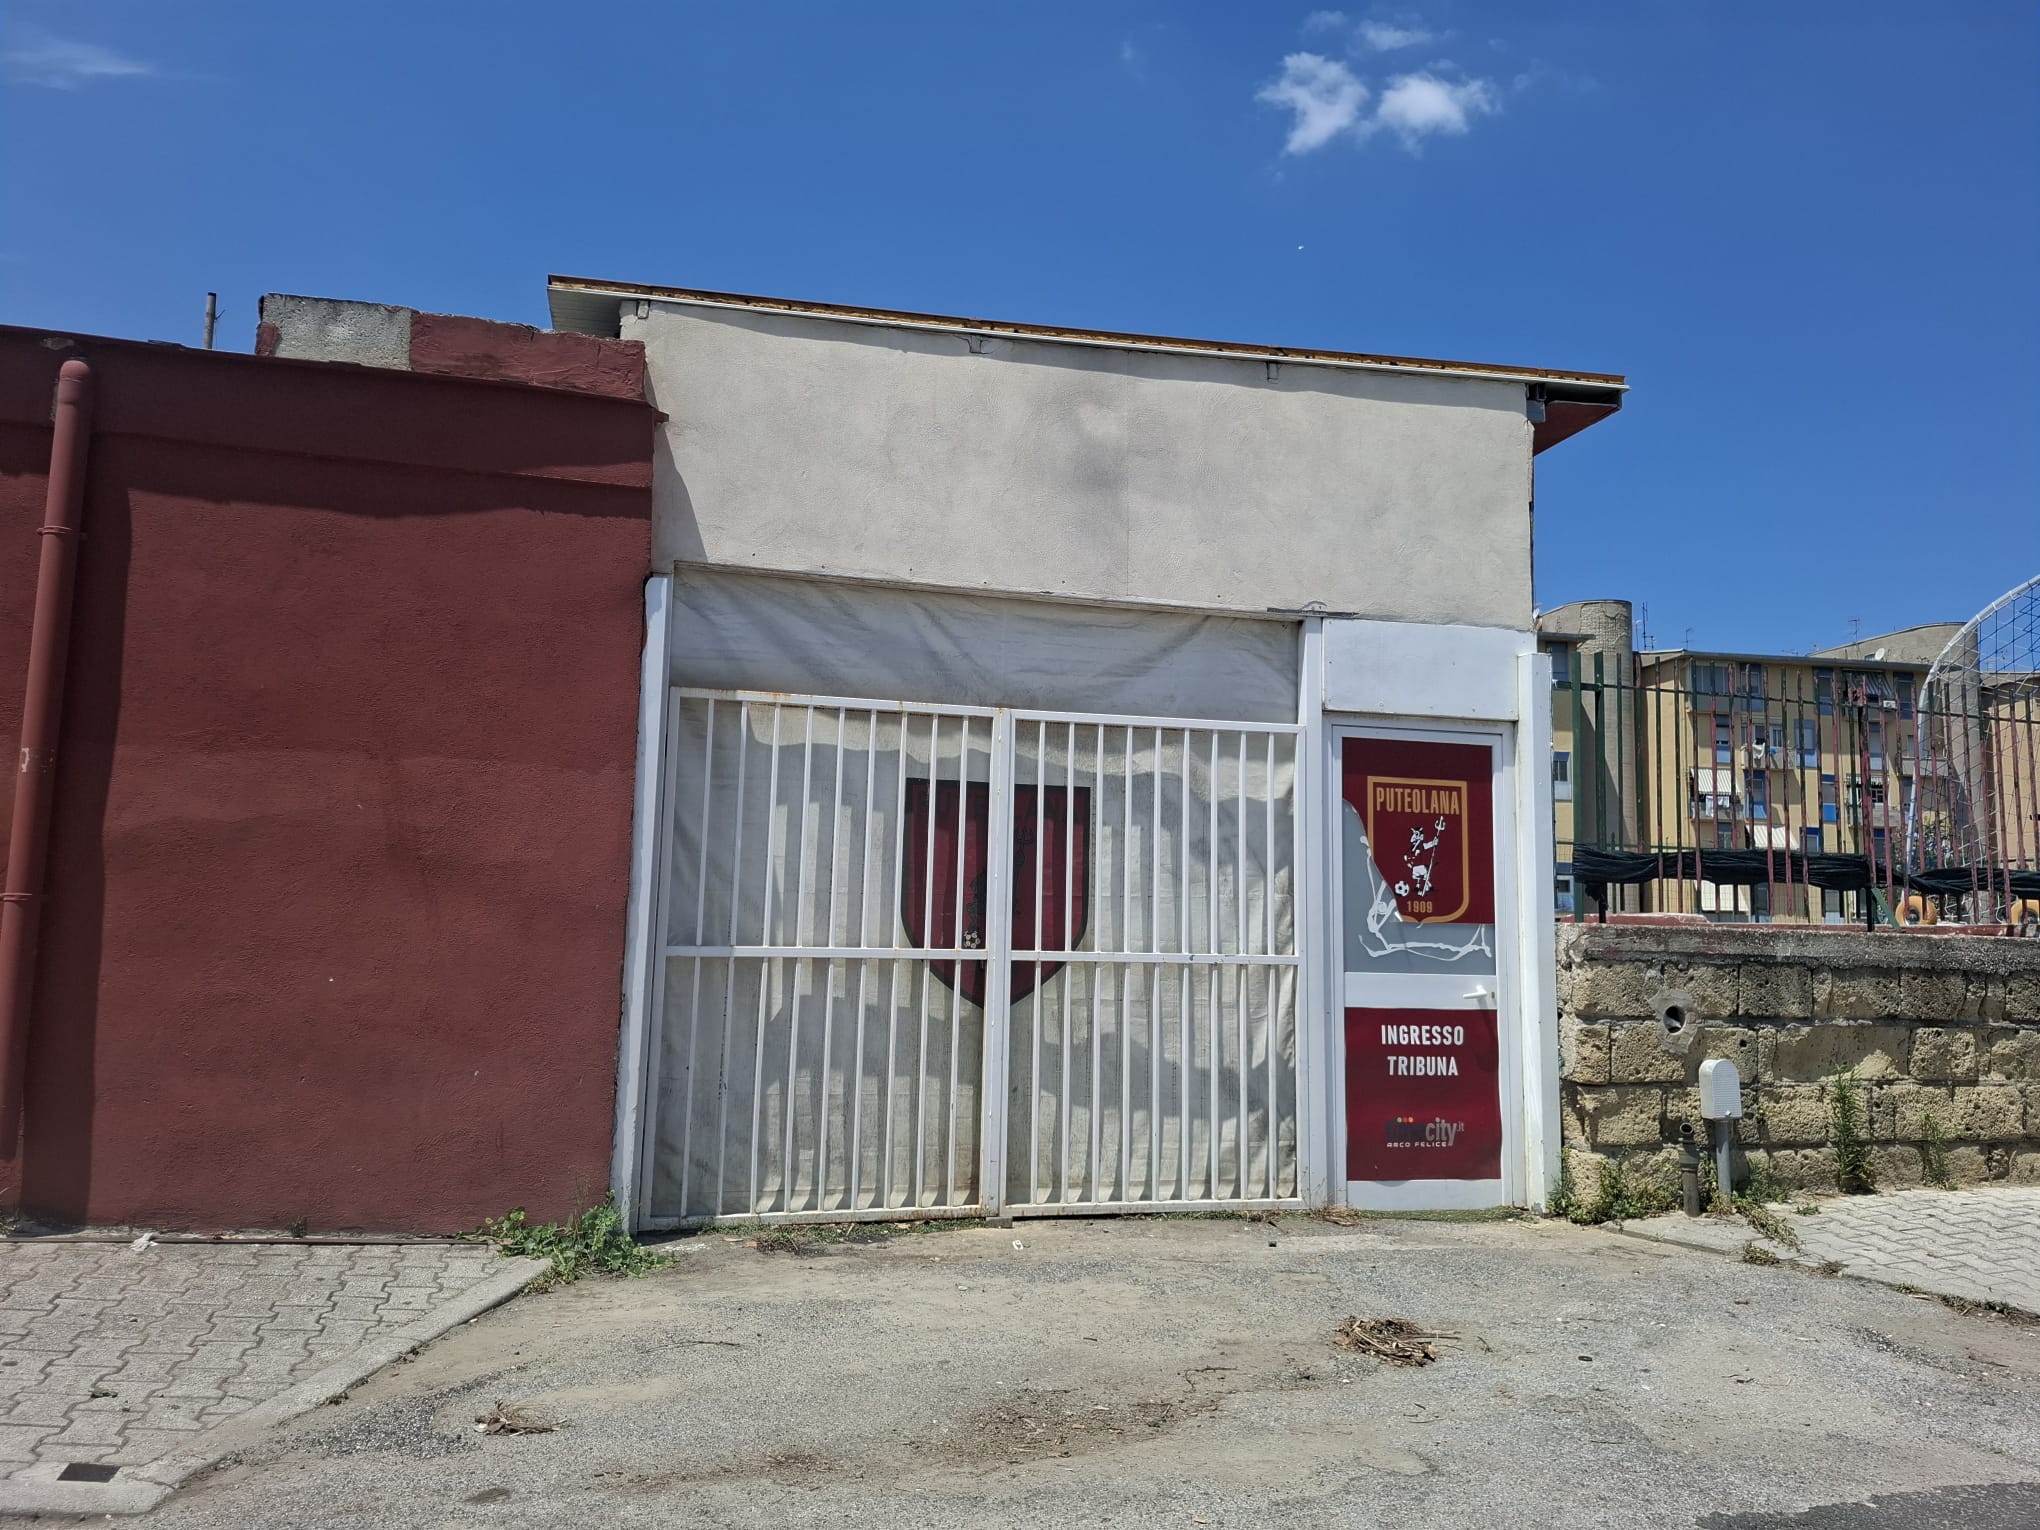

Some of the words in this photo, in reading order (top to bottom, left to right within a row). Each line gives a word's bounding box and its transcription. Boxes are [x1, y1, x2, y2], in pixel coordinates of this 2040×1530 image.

[1376, 787, 1460, 815] PUTEOLANA
[1407, 901, 1433, 913] 1909
[1381, 1024, 1464, 1046] INGRESSO
[1387, 1056, 1459, 1076] TRIBUNA
